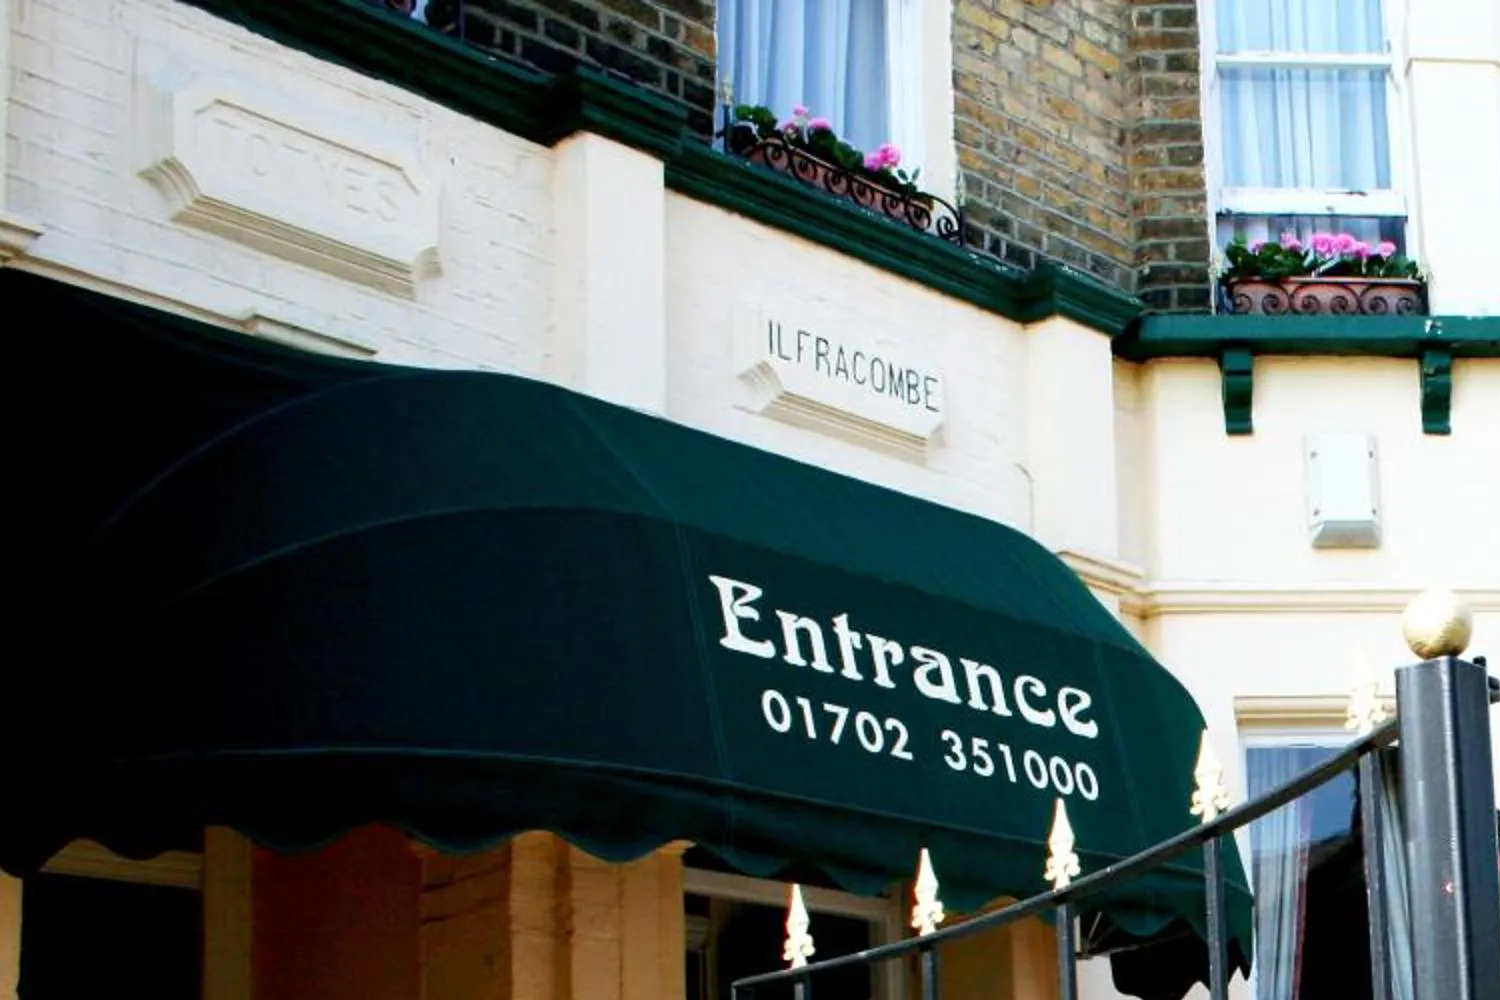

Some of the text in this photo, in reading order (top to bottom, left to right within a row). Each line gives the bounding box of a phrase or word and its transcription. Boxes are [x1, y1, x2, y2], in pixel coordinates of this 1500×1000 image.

[768, 319, 940, 413] ILFRACOMBE
[709, 574, 1099, 739] Entrance
[761, 689, 1099, 800] 01702 351000
